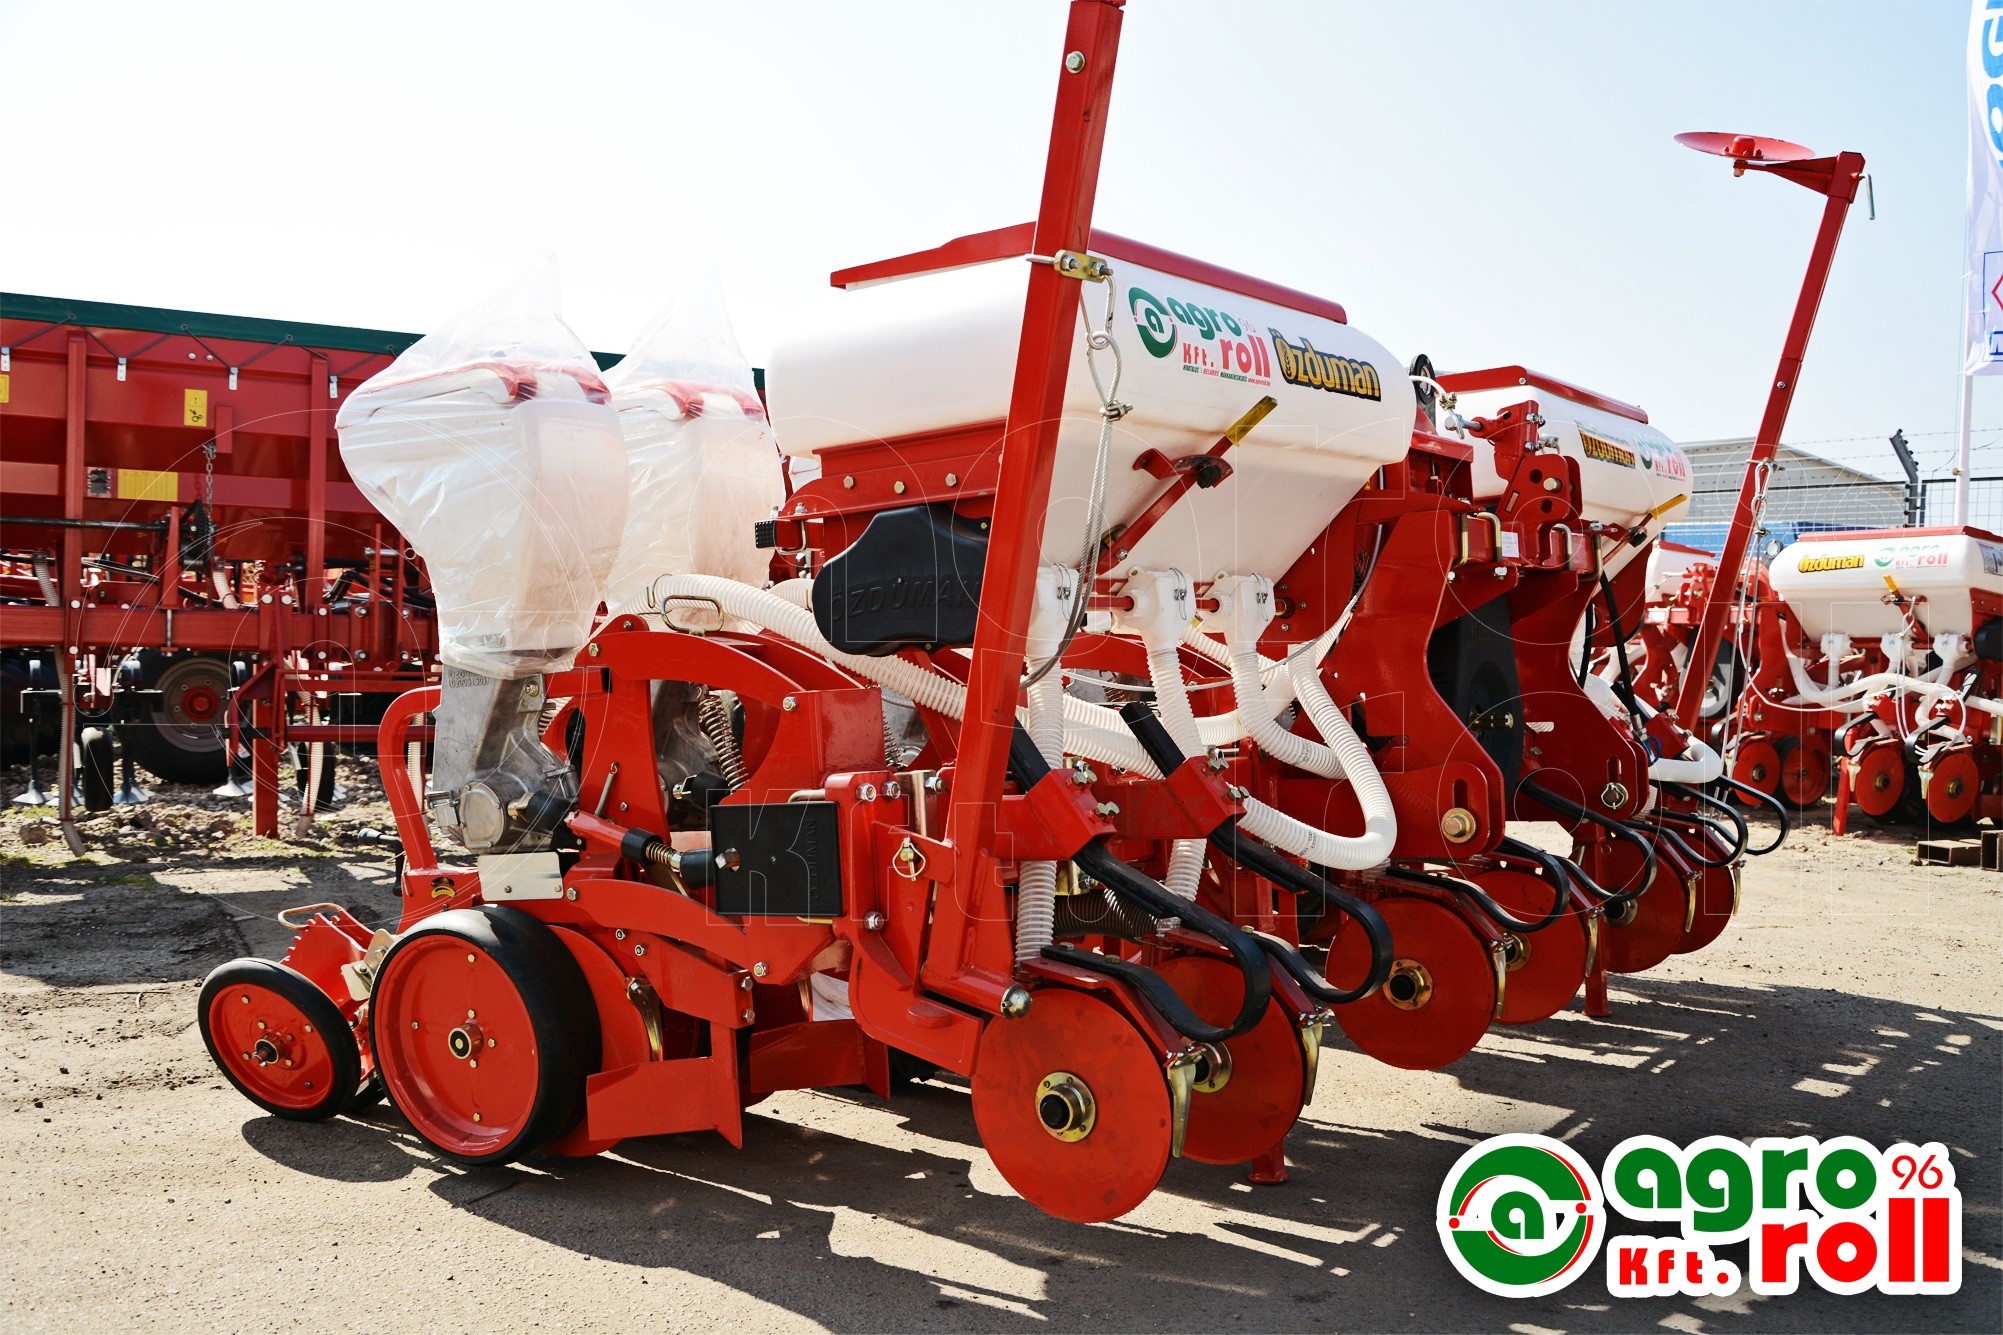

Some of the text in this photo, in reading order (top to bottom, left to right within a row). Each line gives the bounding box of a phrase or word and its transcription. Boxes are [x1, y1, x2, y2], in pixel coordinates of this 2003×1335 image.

[1166, 296, 1242, 341] agro
[1182, 334, 1271, 379] Kft. roll
[1268, 328, 1381, 400] Özduman
[1798, 554, 1865, 573] Özduman
[1917, 552, 1949, 566] roll
